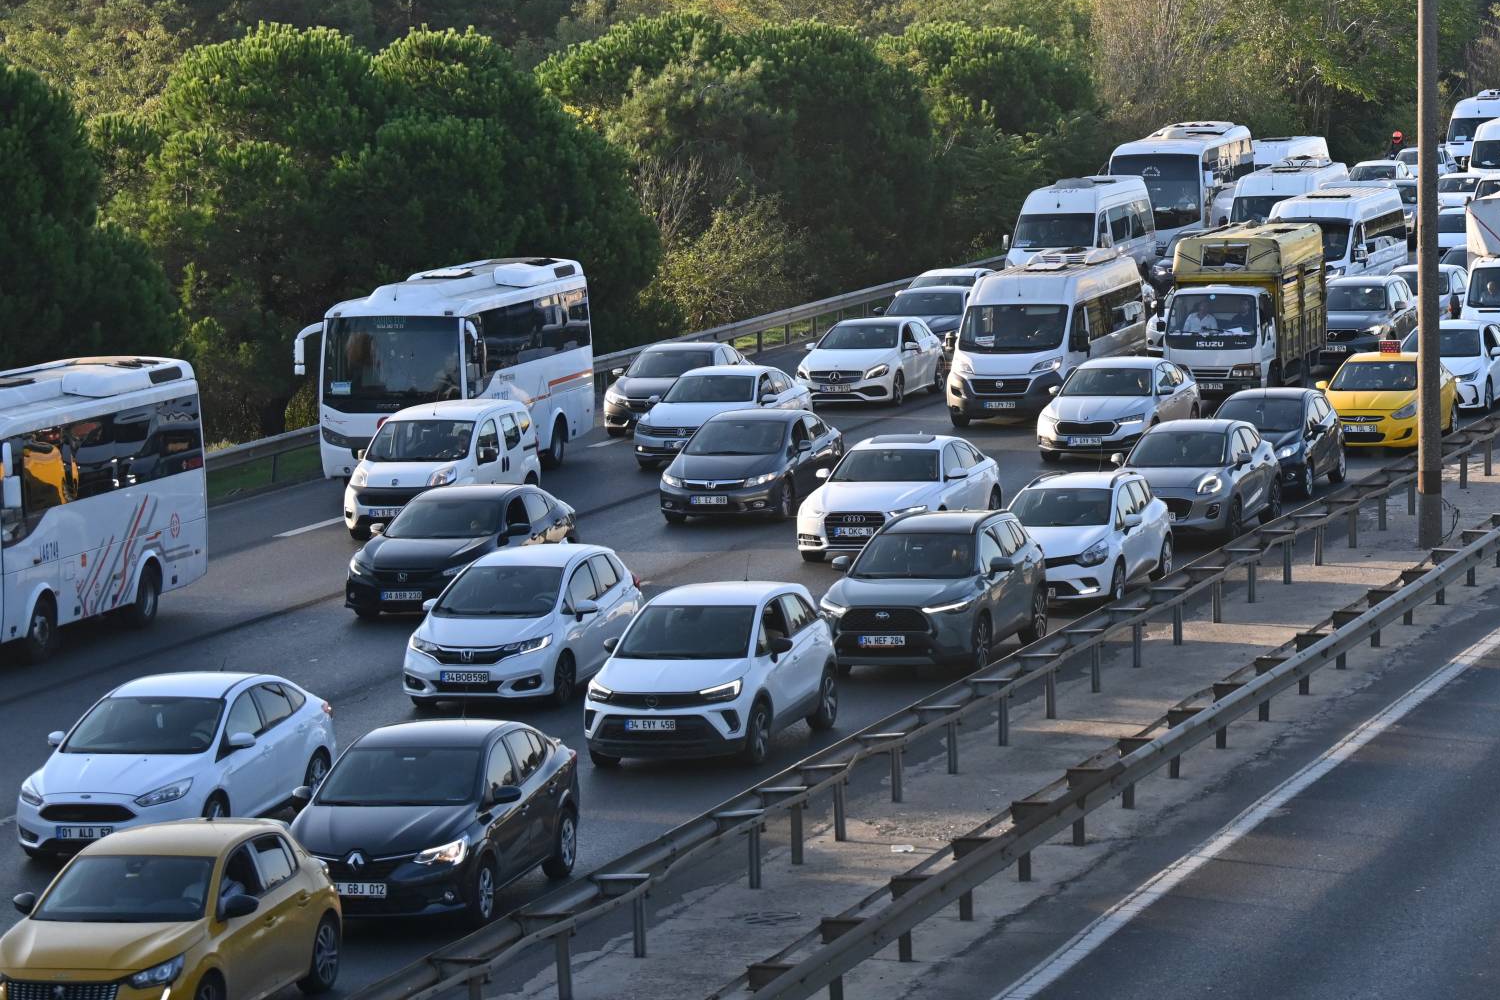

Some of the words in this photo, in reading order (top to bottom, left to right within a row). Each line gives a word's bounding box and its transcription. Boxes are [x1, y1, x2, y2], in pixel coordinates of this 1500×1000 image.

[863, 636, 871, 645] 34
[874, 636, 887, 644] HEF
[890, 636, 903, 645] 284
[629, 720, 638, 728] 34
[642, 720, 655, 728] EVY
[62, 828, 71, 837] 01
[79, 828, 93, 838] ALD
[369, 884, 385, 894] 012
